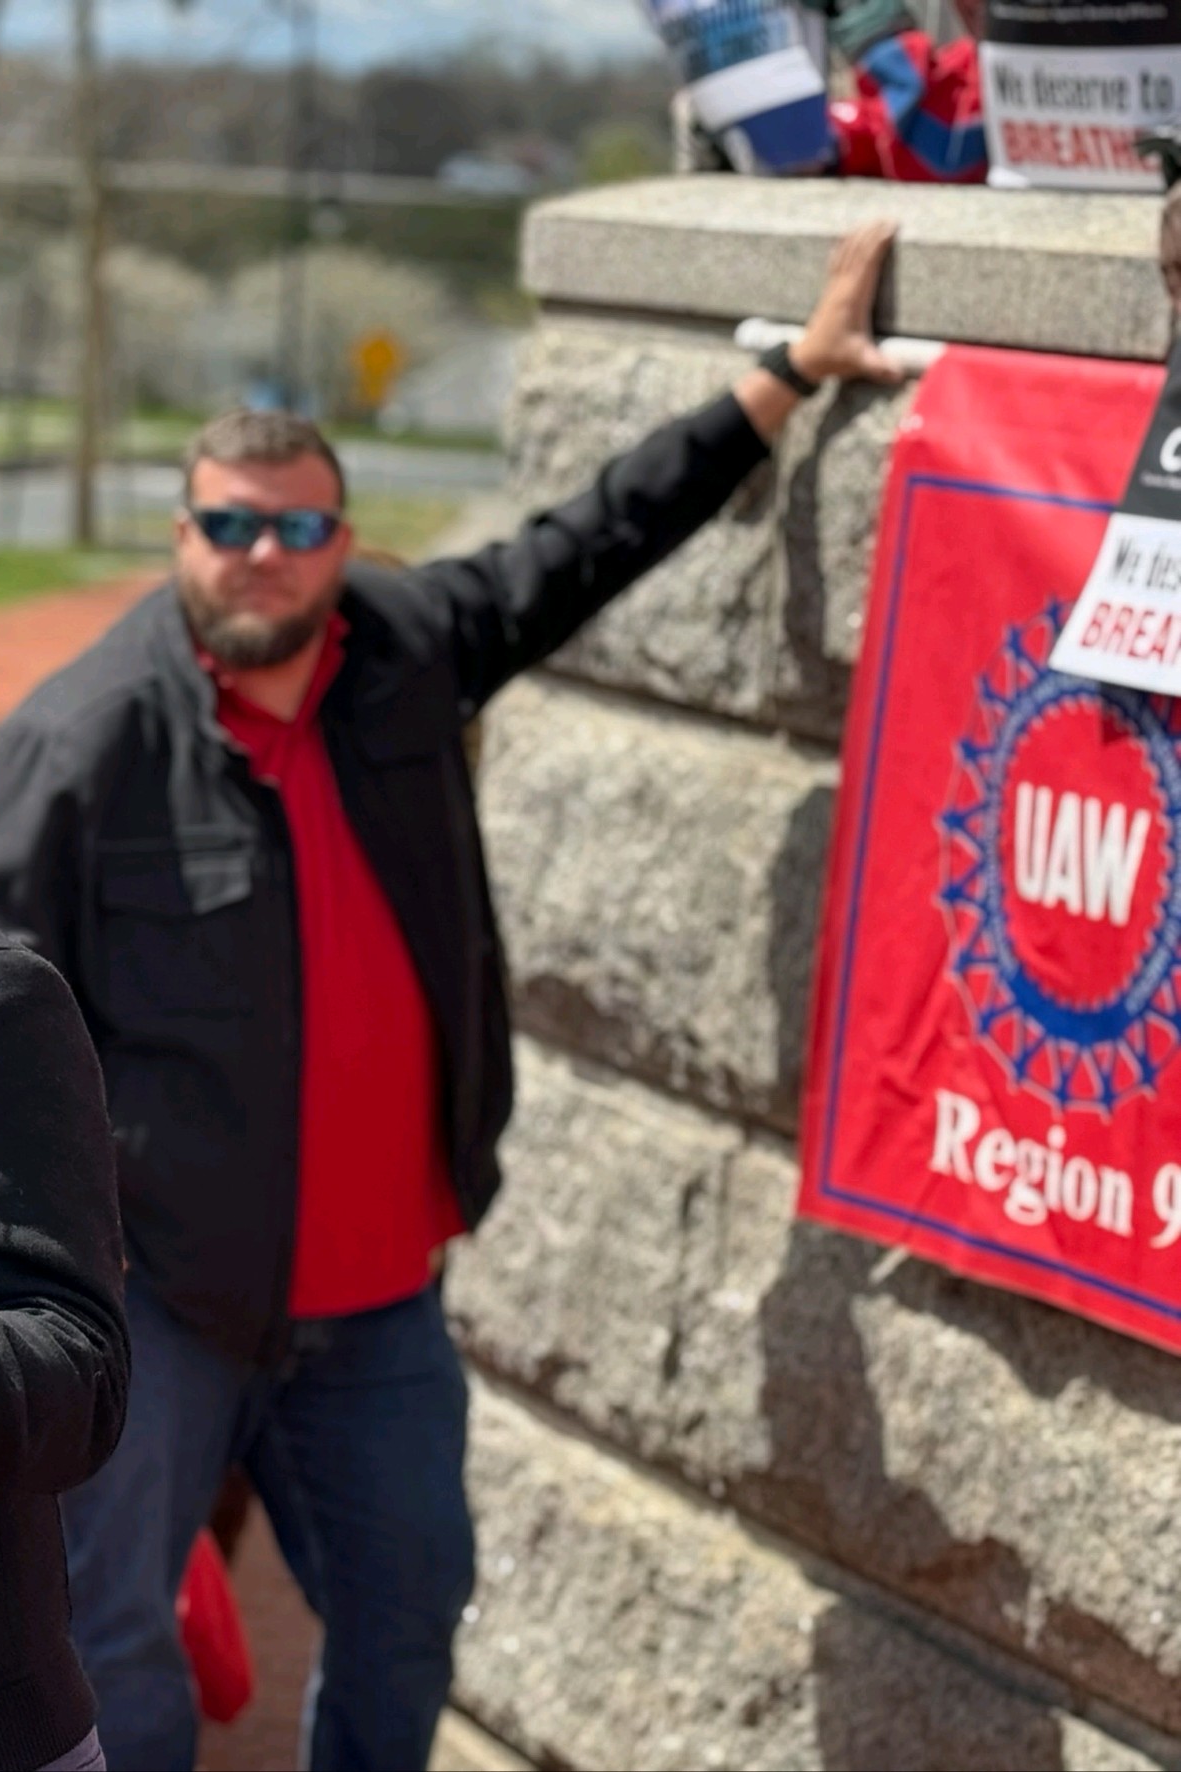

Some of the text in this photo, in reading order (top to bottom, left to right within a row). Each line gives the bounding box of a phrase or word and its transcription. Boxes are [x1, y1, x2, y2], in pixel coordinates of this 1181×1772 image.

[994, 63, 1174, 113] We deserve to
[1079, 602, 1181, 667] BREA
[1013, 781, 1152, 927] UAW
[928, 1088, 1135, 1237] Region
